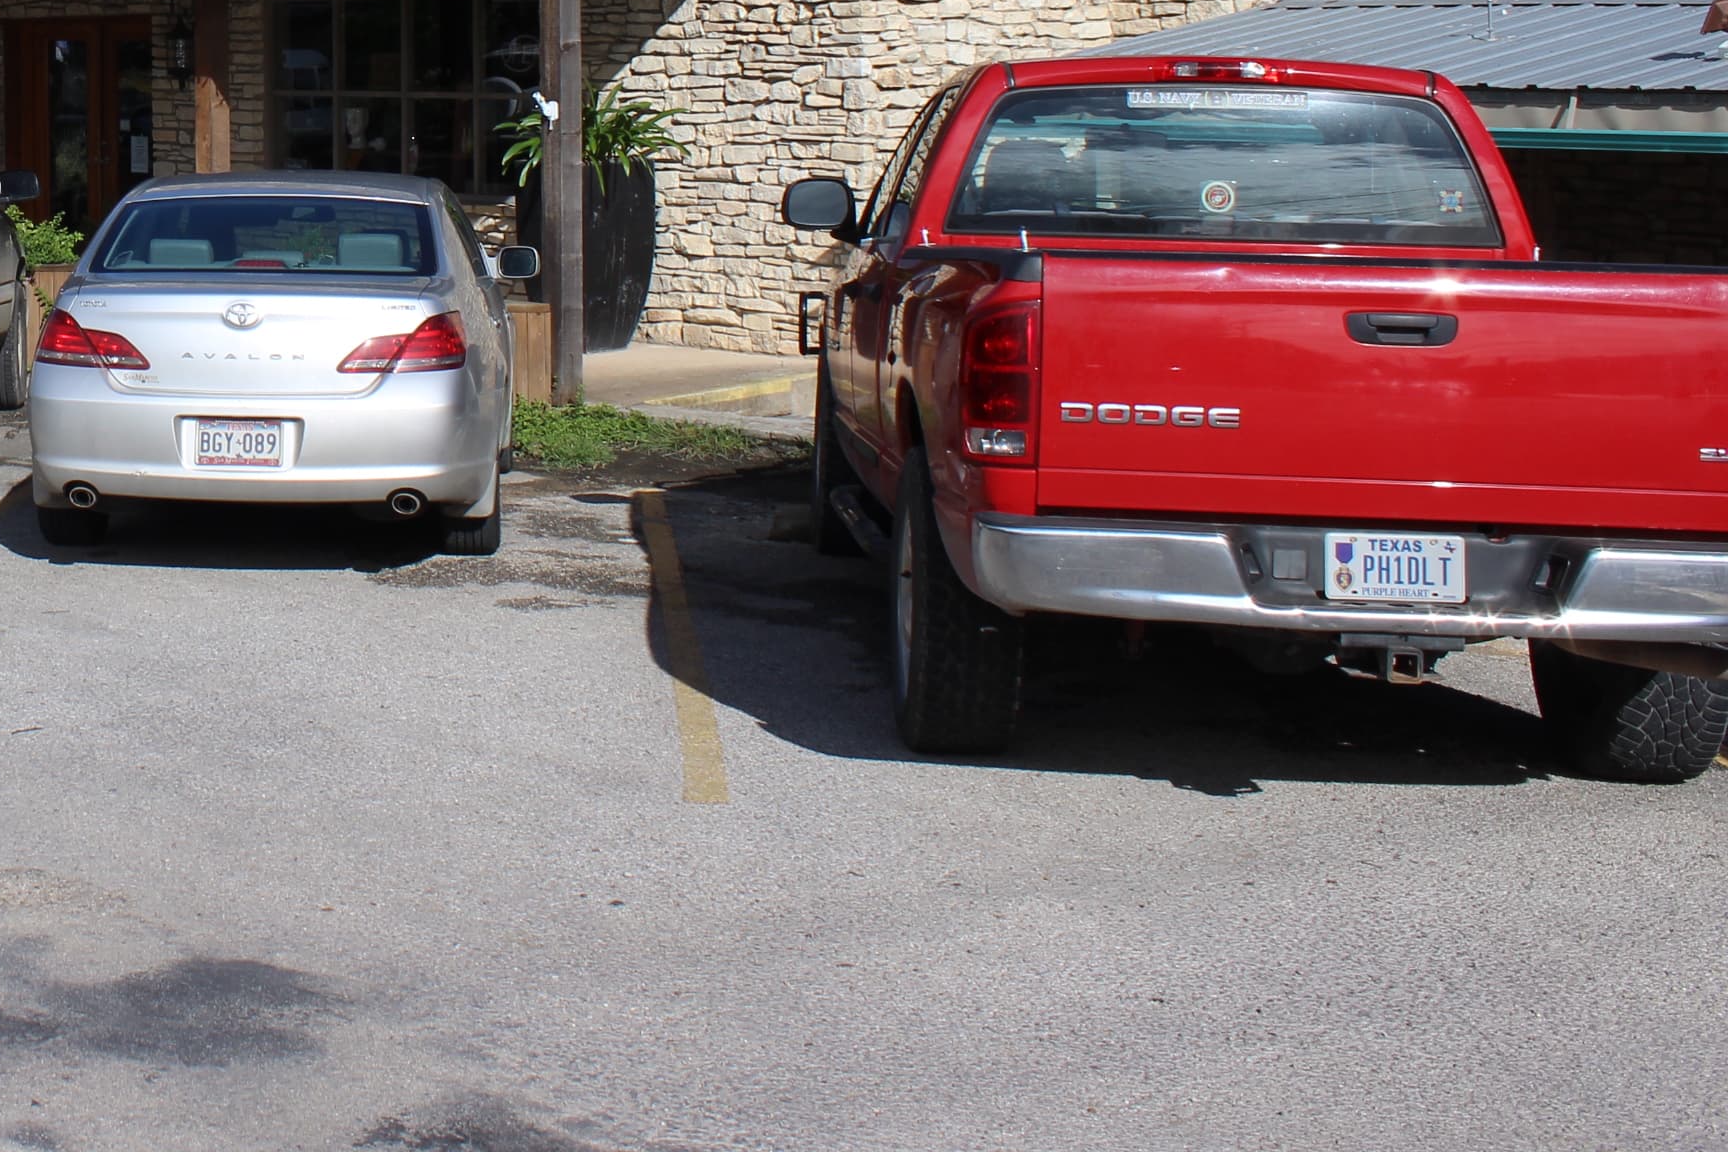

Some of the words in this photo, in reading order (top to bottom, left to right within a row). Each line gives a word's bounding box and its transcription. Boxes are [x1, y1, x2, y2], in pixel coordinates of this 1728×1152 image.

[1128, 91, 1155, 104] U.S.
[1160, 91, 1201, 104] NAVY
[1231, 93, 1305, 106] VETERAN
[181, 351, 305, 361] AVALON
[1059, 401, 1241, 428] DODGE
[1368, 538, 1423, 553] TEXAS
[1361, 586, 1396, 598] PURPLE
[1398, 588, 1430, 598] HEART
